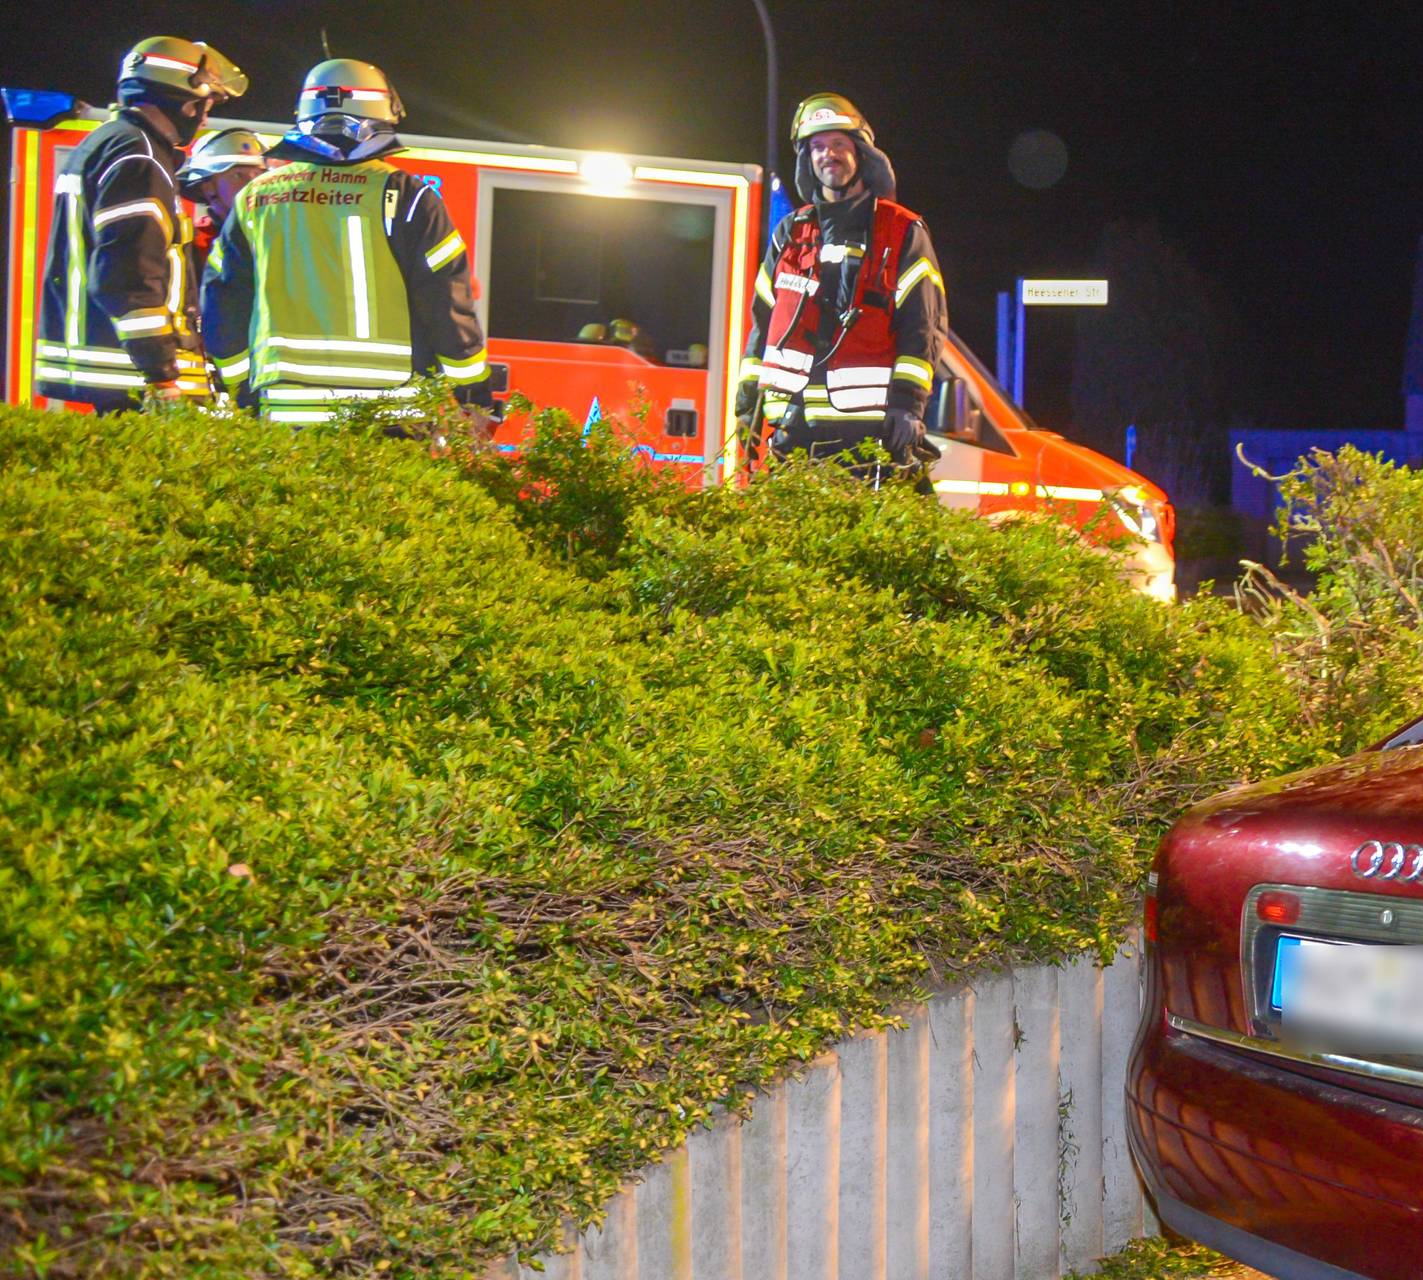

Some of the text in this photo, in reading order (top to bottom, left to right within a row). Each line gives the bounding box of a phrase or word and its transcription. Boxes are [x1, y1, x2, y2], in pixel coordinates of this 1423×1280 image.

[256, 168, 367, 185] erwehr Hamm
[246, 188, 364, 210] Einsatzleiter
